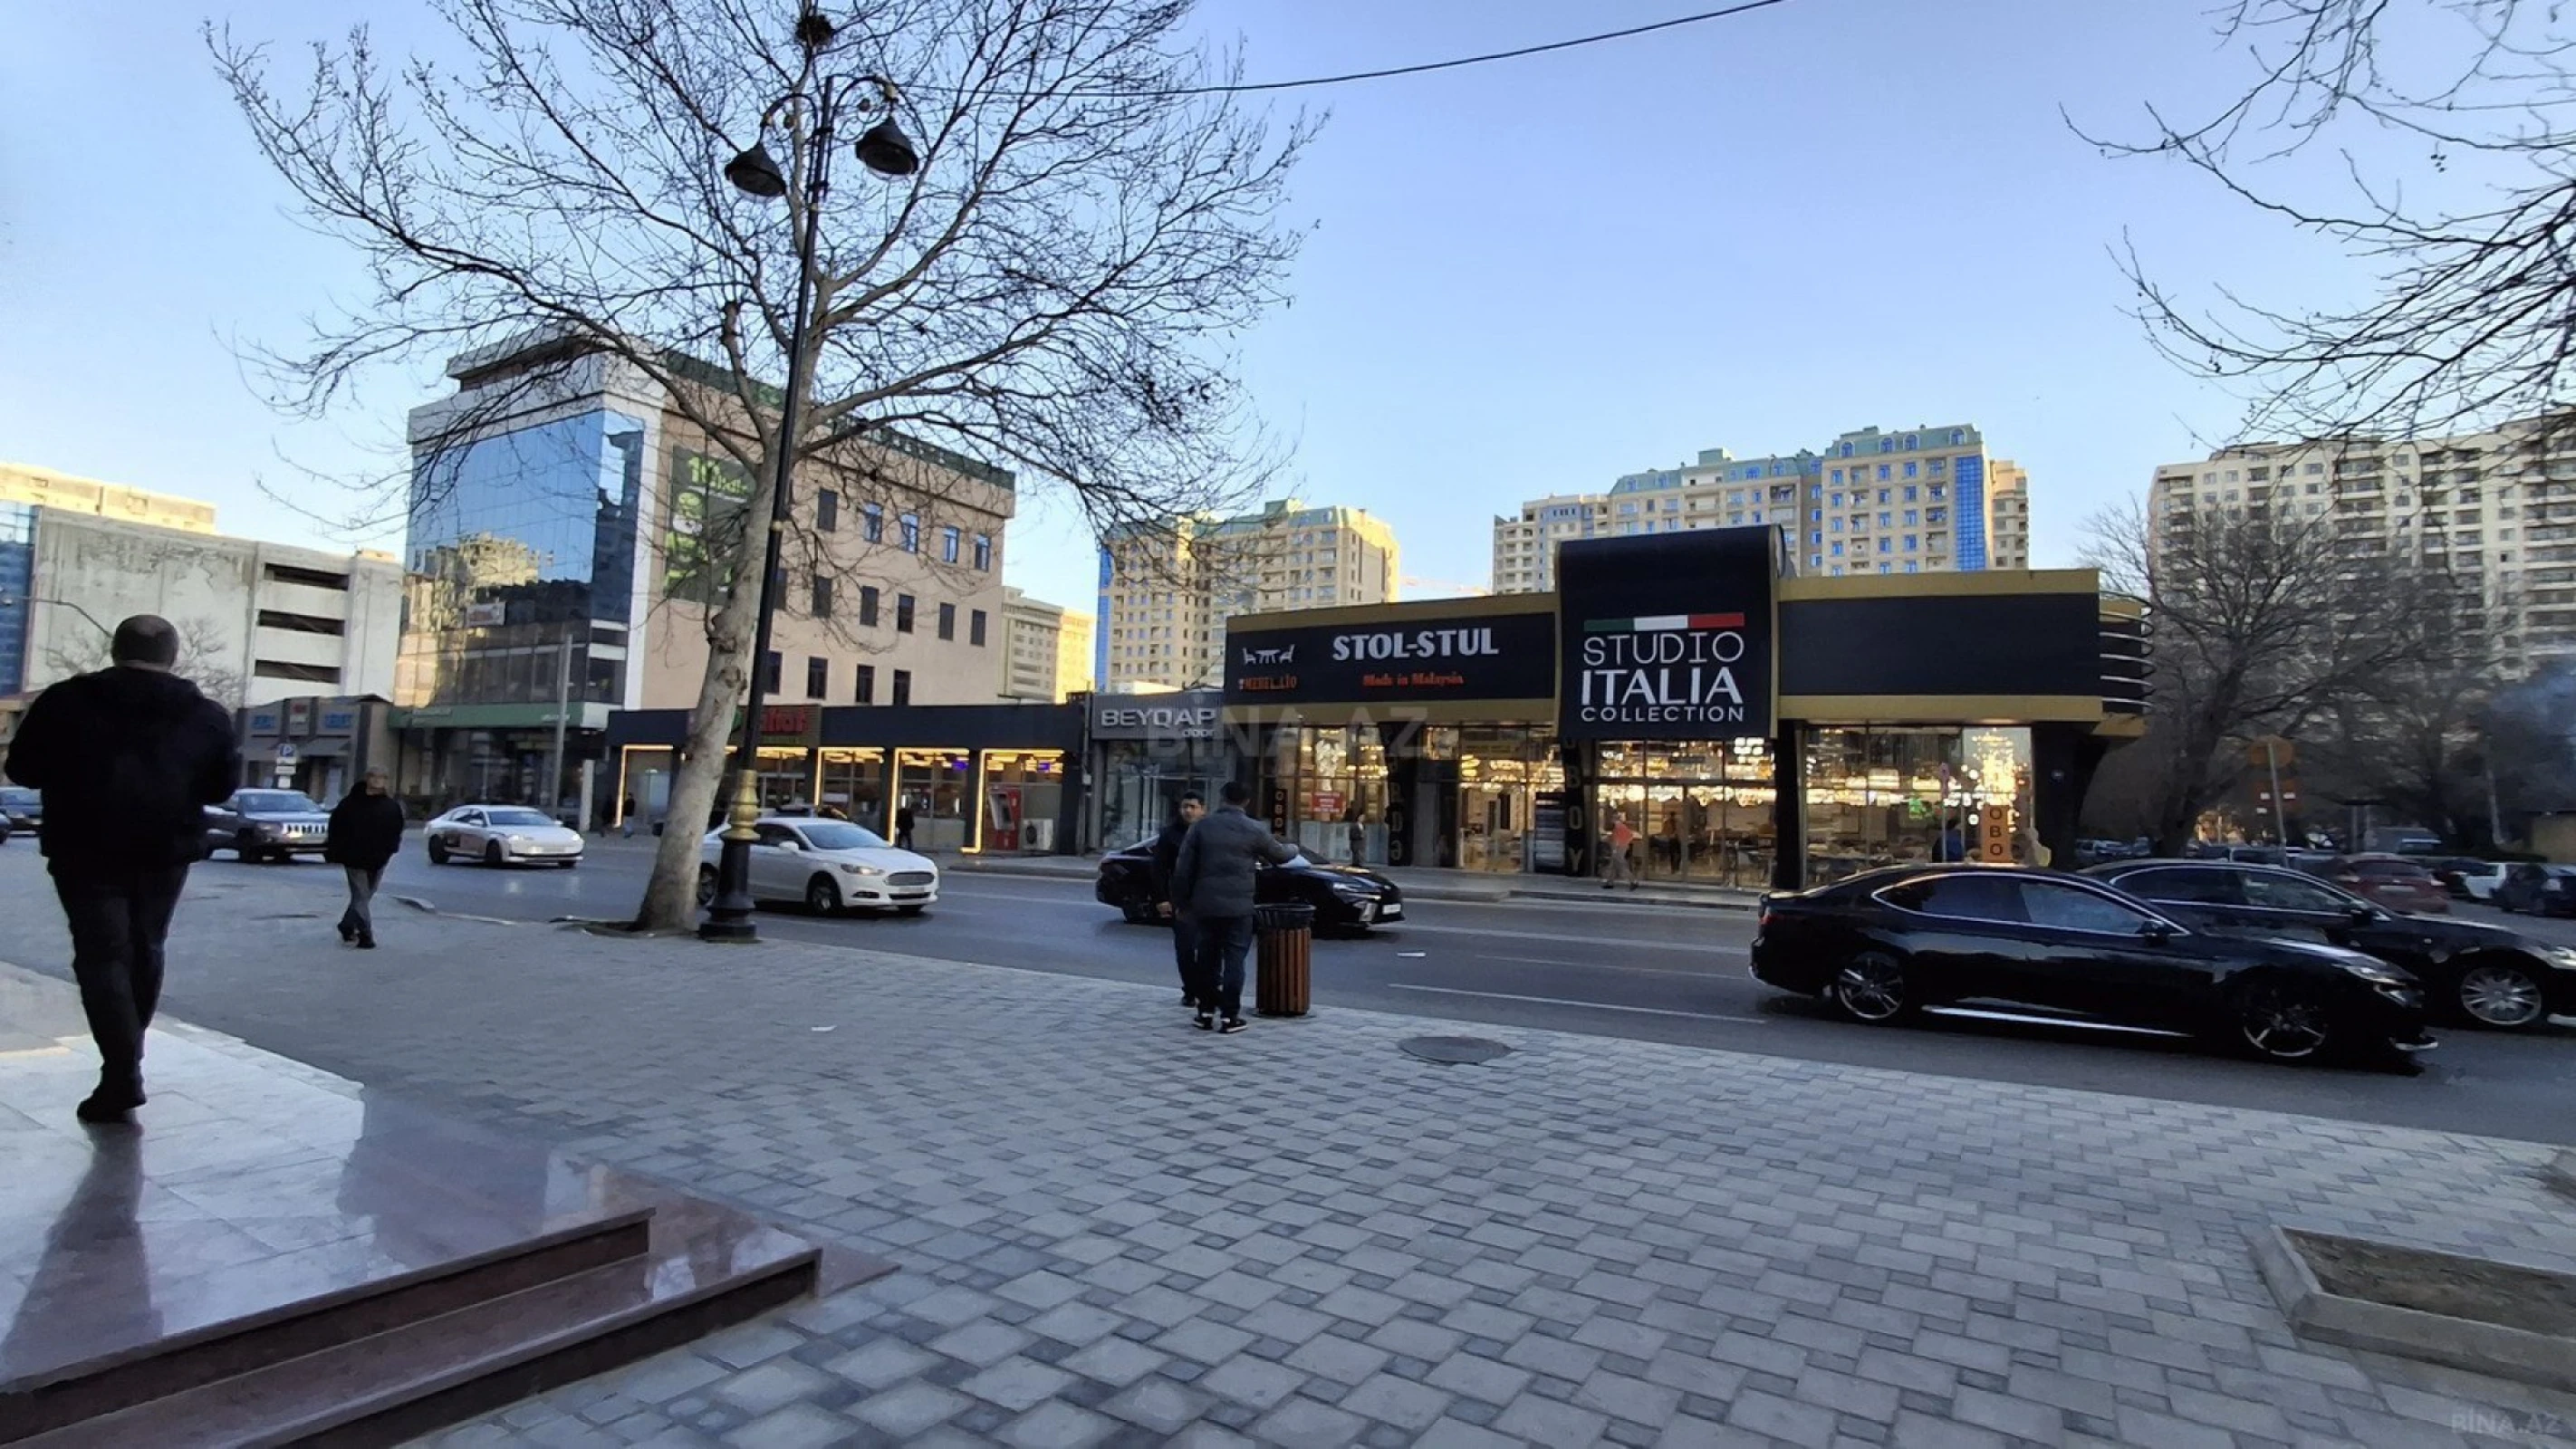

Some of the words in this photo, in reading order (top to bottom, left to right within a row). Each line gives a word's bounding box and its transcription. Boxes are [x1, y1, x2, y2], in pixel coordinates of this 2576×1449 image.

[1332, 628, 1498, 661] STOL-STUL
[1583, 631, 1745, 666] STUDIO
[1363, 673, 1392, 686] Made
[1397, 673, 1408, 686] in
[1411, 671, 1464, 687] Malaysia
[1581, 666, 1744, 705] ITALIA
[1101, 708, 1216, 728] BEYQAP
[1581, 705, 1744, 722] COLLECTION
